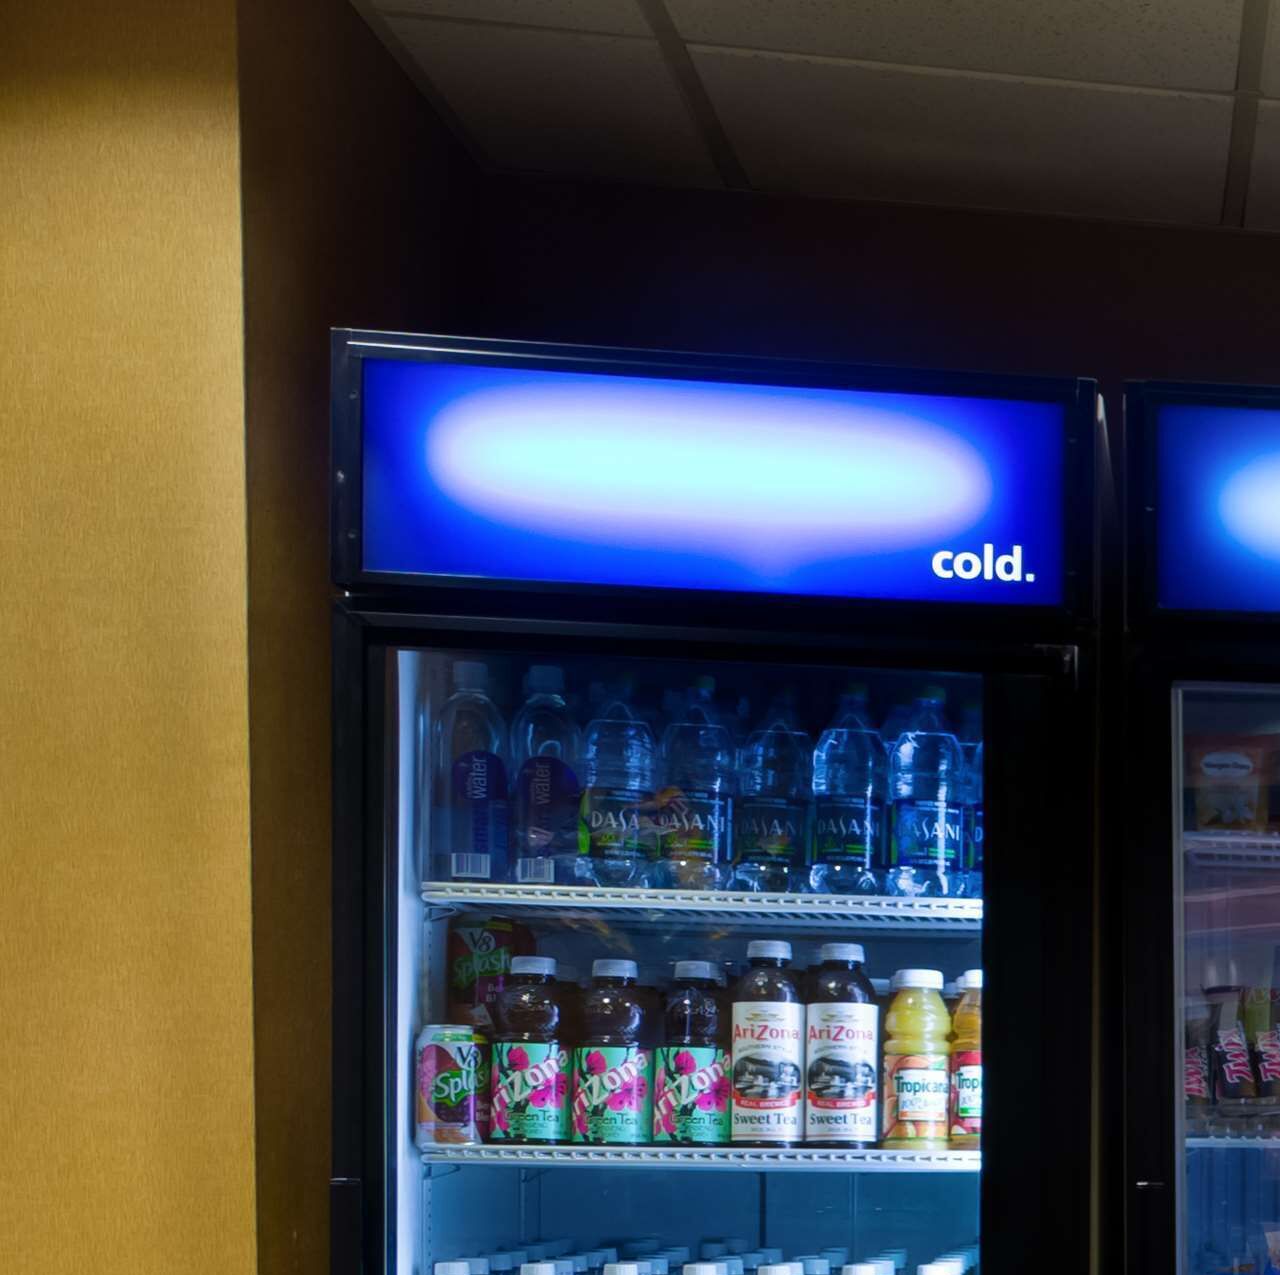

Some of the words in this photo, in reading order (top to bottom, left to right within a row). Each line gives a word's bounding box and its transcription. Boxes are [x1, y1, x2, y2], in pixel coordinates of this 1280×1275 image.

[932, 543, 1035, 582] cold.
[911, 817, 961, 842] ASANI
[733, 1023, 800, 1043] AriZona
[808, 1025, 874, 1043] AriZona
[894, 1076, 948, 1096] Tropicana
[733, 1112, 771, 1126] Sweet
[773, 1112, 798, 1126] Tea
[809, 1112, 849, 1126] Sweet
